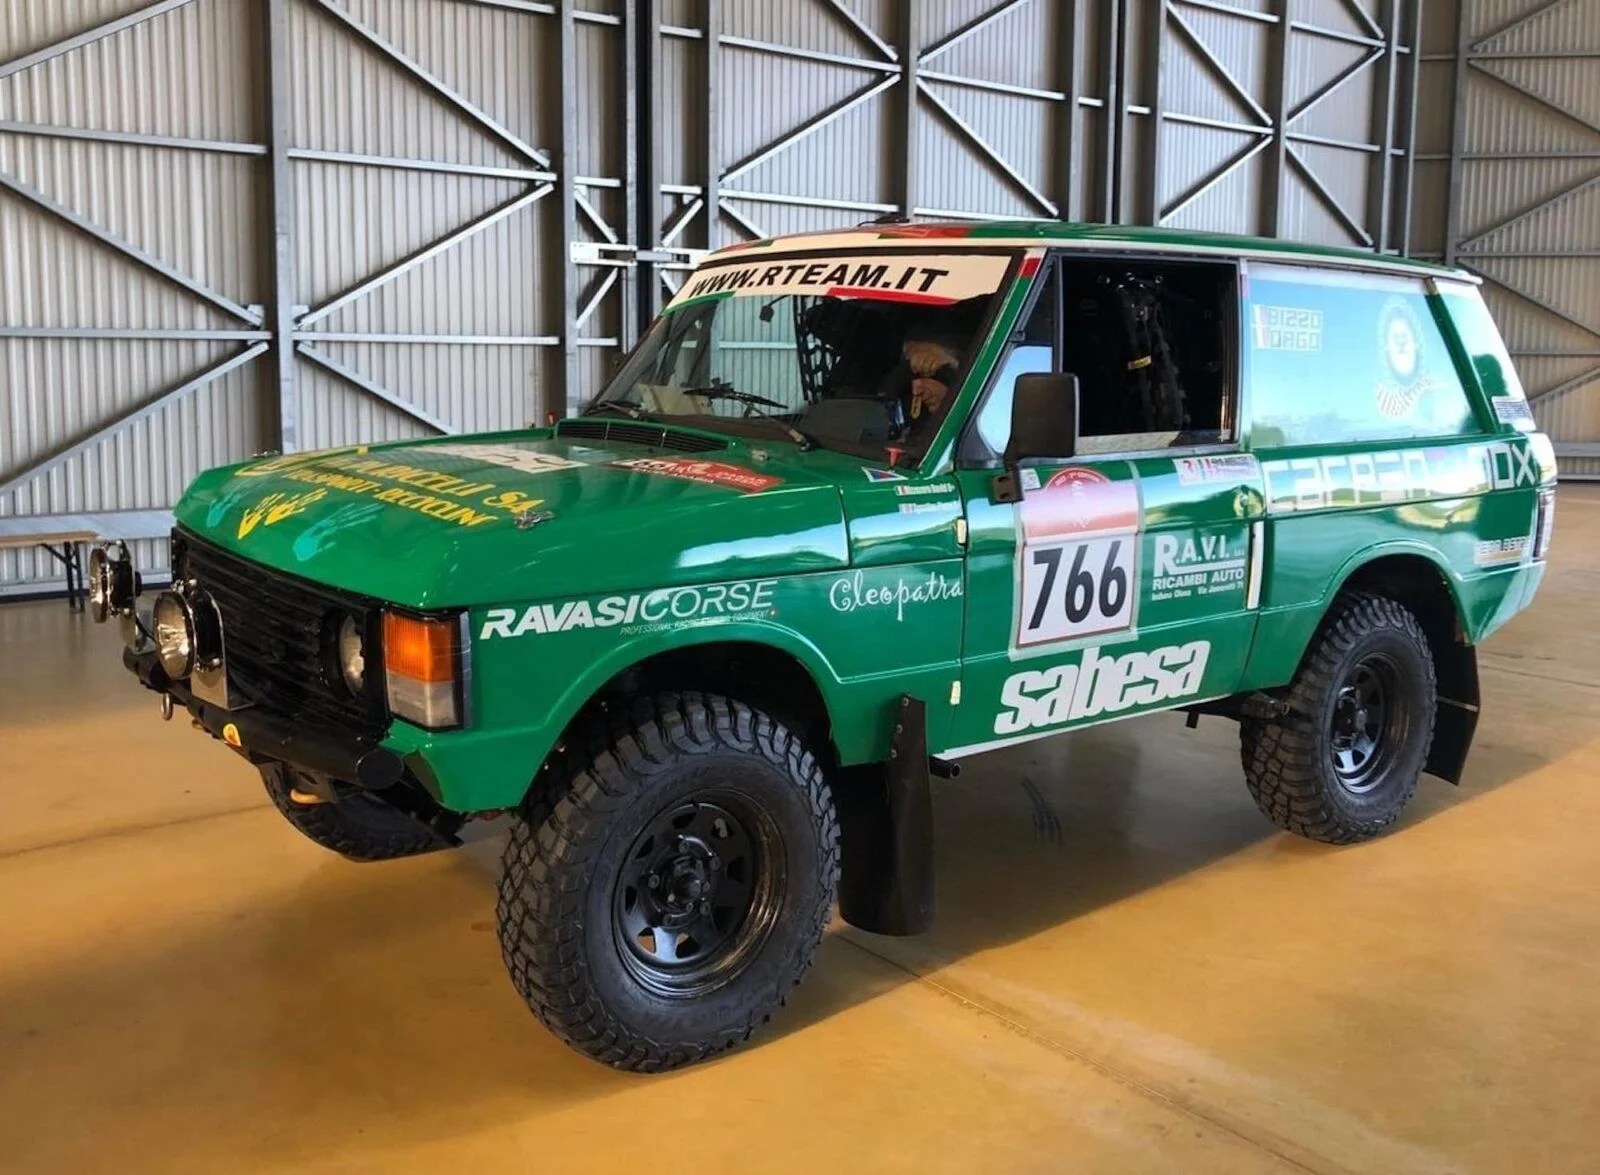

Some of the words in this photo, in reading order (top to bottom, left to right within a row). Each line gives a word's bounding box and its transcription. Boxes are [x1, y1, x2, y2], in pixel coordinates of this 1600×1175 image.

[688, 264, 950, 298] WWW.RTEAM.IT
[1153, 535, 1230, 578] R.A.V.I.
[829, 569, 964, 622] Cleopatra
[1028, 540, 1127, 630] 766
[1152, 573, 1207, 591] RICAMBI
[1211, 568, 1245, 583] AUTO
[620, 622, 675, 636] PROFESSIONAL
[994, 640, 1211, 734] sabesa
